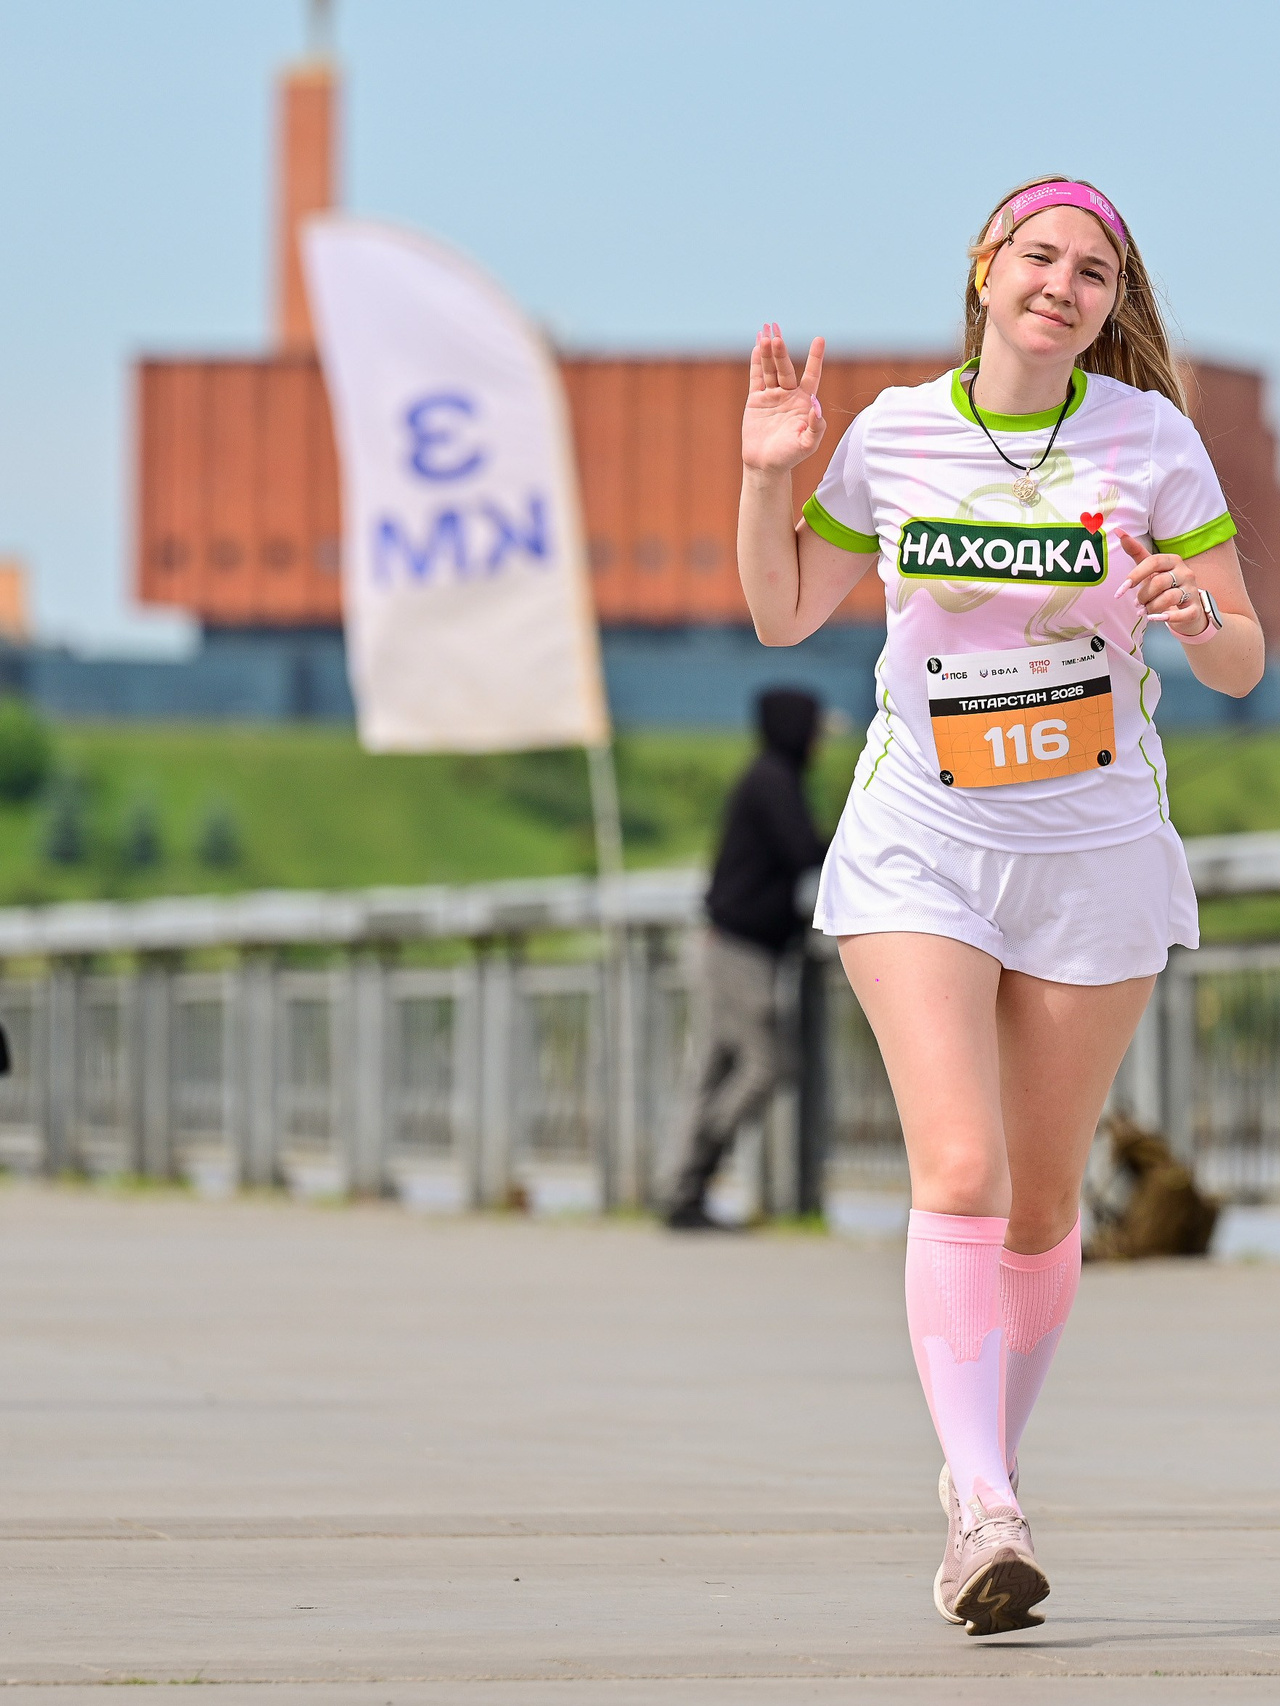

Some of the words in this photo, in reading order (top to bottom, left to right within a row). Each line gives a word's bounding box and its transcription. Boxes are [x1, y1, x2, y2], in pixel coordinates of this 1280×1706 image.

[903, 533, 1101, 577] НАХОДКА
[991, 666, 1019, 676] ВФЛА
[1028, 659, 1051, 669] ЭТНО
[950, 671, 968, 680] ПСБ
[959, 692, 1047, 711] ТАТАРСТАН
[1050, 685, 1085, 701] 2026
[983, 718, 1070, 768] 116
